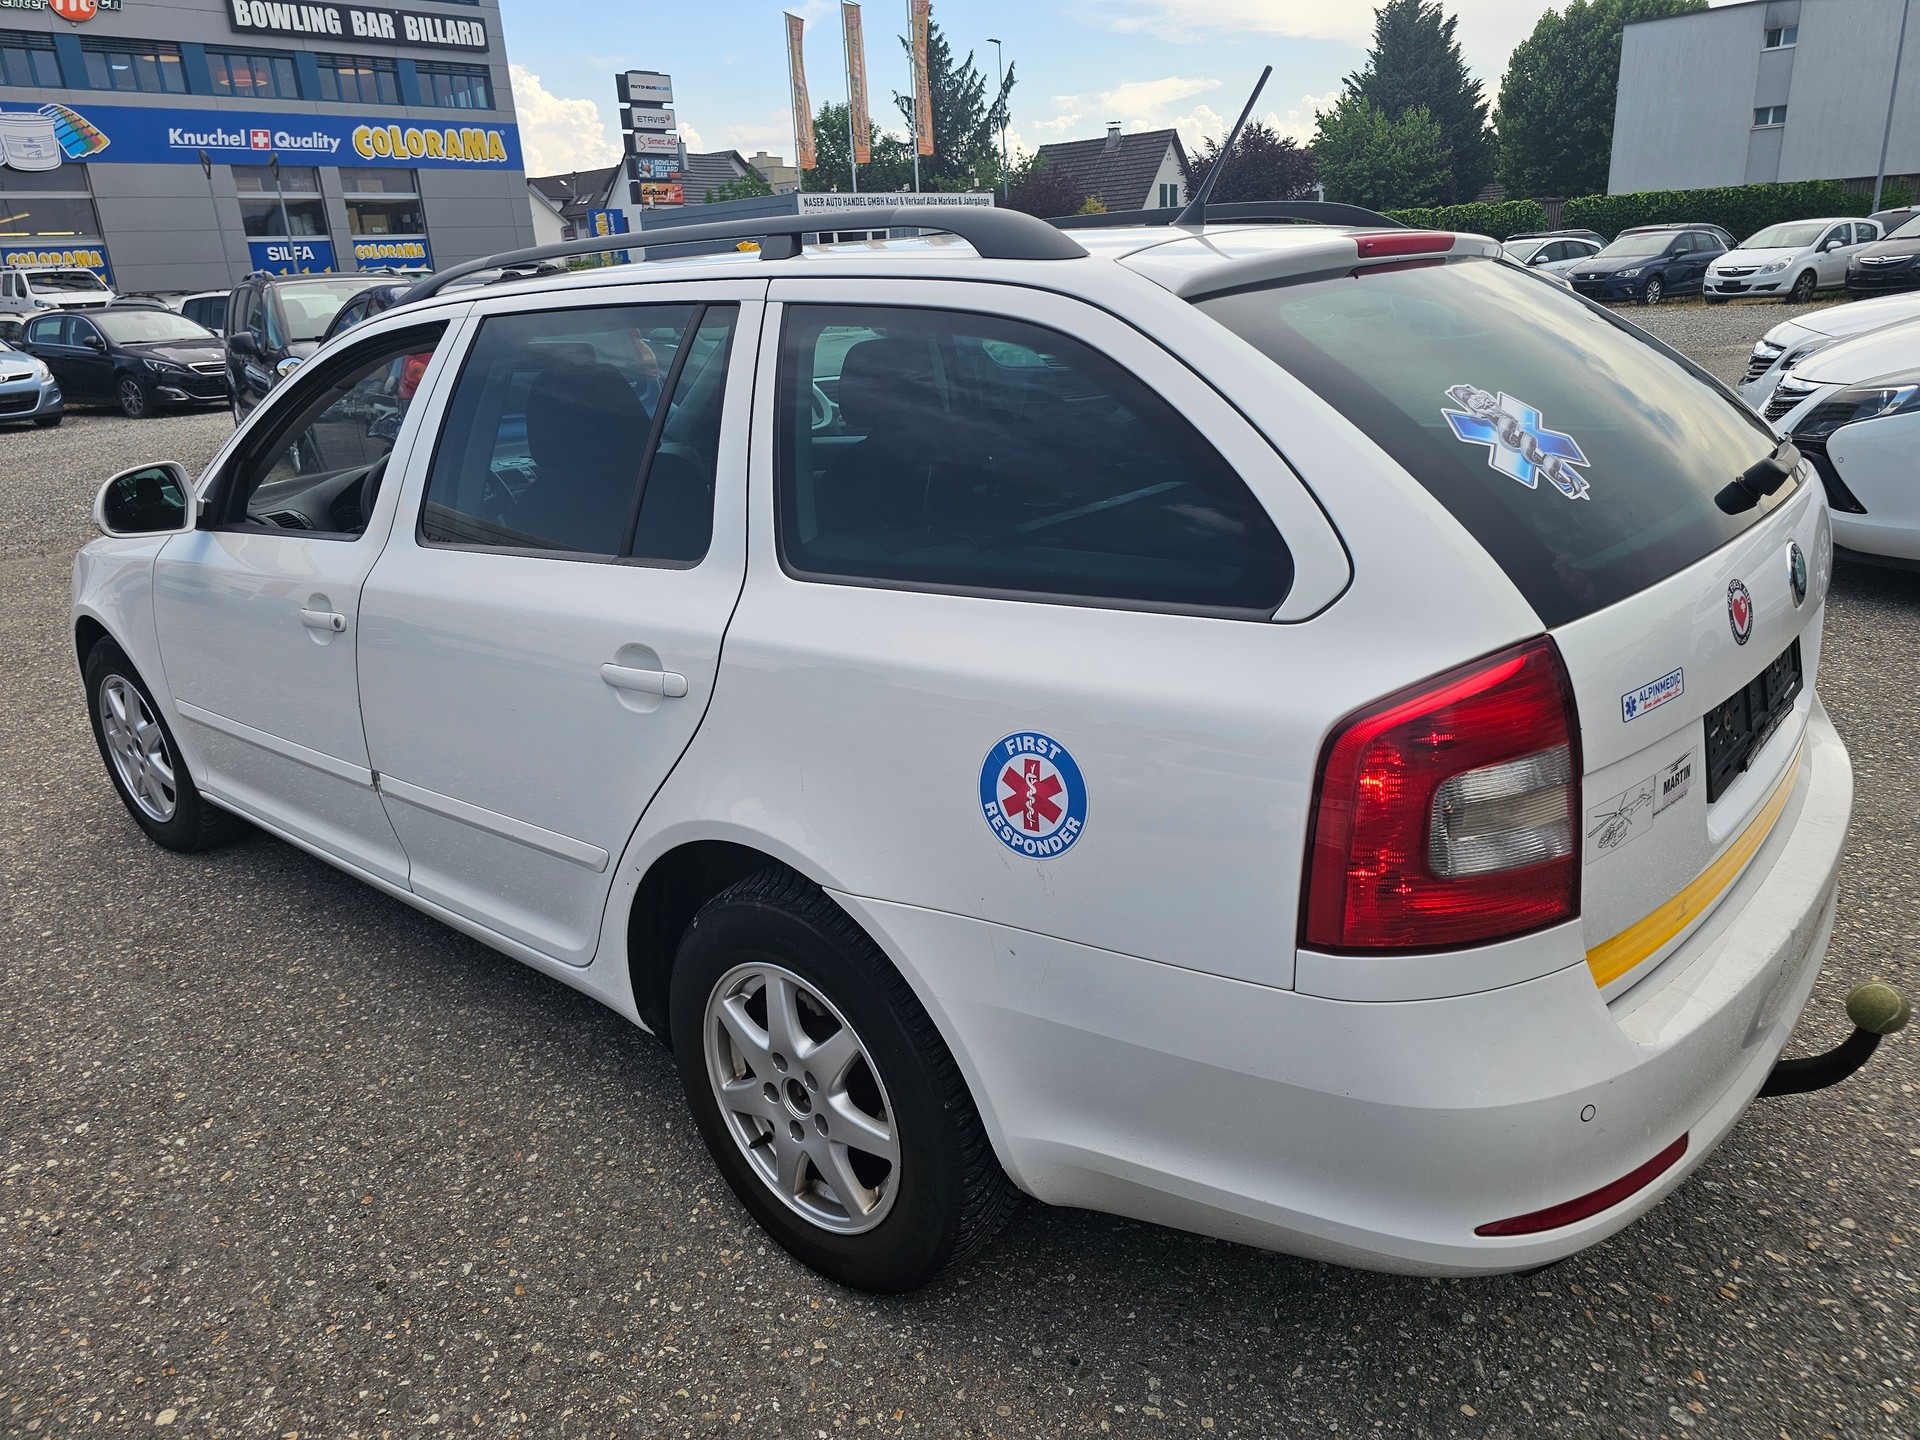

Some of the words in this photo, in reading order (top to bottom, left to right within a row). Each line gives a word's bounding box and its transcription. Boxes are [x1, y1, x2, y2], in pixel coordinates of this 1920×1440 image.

[232, 0, 342, 35] BOWLING
[350, 10, 396, 39] BAR
[404, 15, 486, 47] BILLARD
[637, 115, 666, 124] ETAVIS
[168, 128, 246, 146] Knuchel
[274, 131, 341, 153] Quality
[353, 125, 507, 162] COLORAMA
[647, 137, 666, 145] Simec
[667, 138, 676, 146] AG
[804, 197, 825, 207] NASER
[826, 197, 842, 207] AUTO
[843, 196, 867, 206] HANDEL
[868, 196, 885, 206] GMBH
[886, 196, 899, 206] Kauf
[905, 196, 925, 206] Verkauf
[927, 197, 937, 206] Alle
[939, 197, 957, 206] Marken
[964, 196, 990, 207] Jahrgänge
[7, 249, 104, 268] COLORAMA
[267, 246, 315, 261] SILFA
[355, 243, 426, 260] COLORAMA
[1639, 673, 1681, 703] ALPINMEDIC
[1005, 736, 1061, 760] FIRST
[1663, 764, 1691, 795] MARTIN
[985, 801, 1082, 856] RESPONDER
